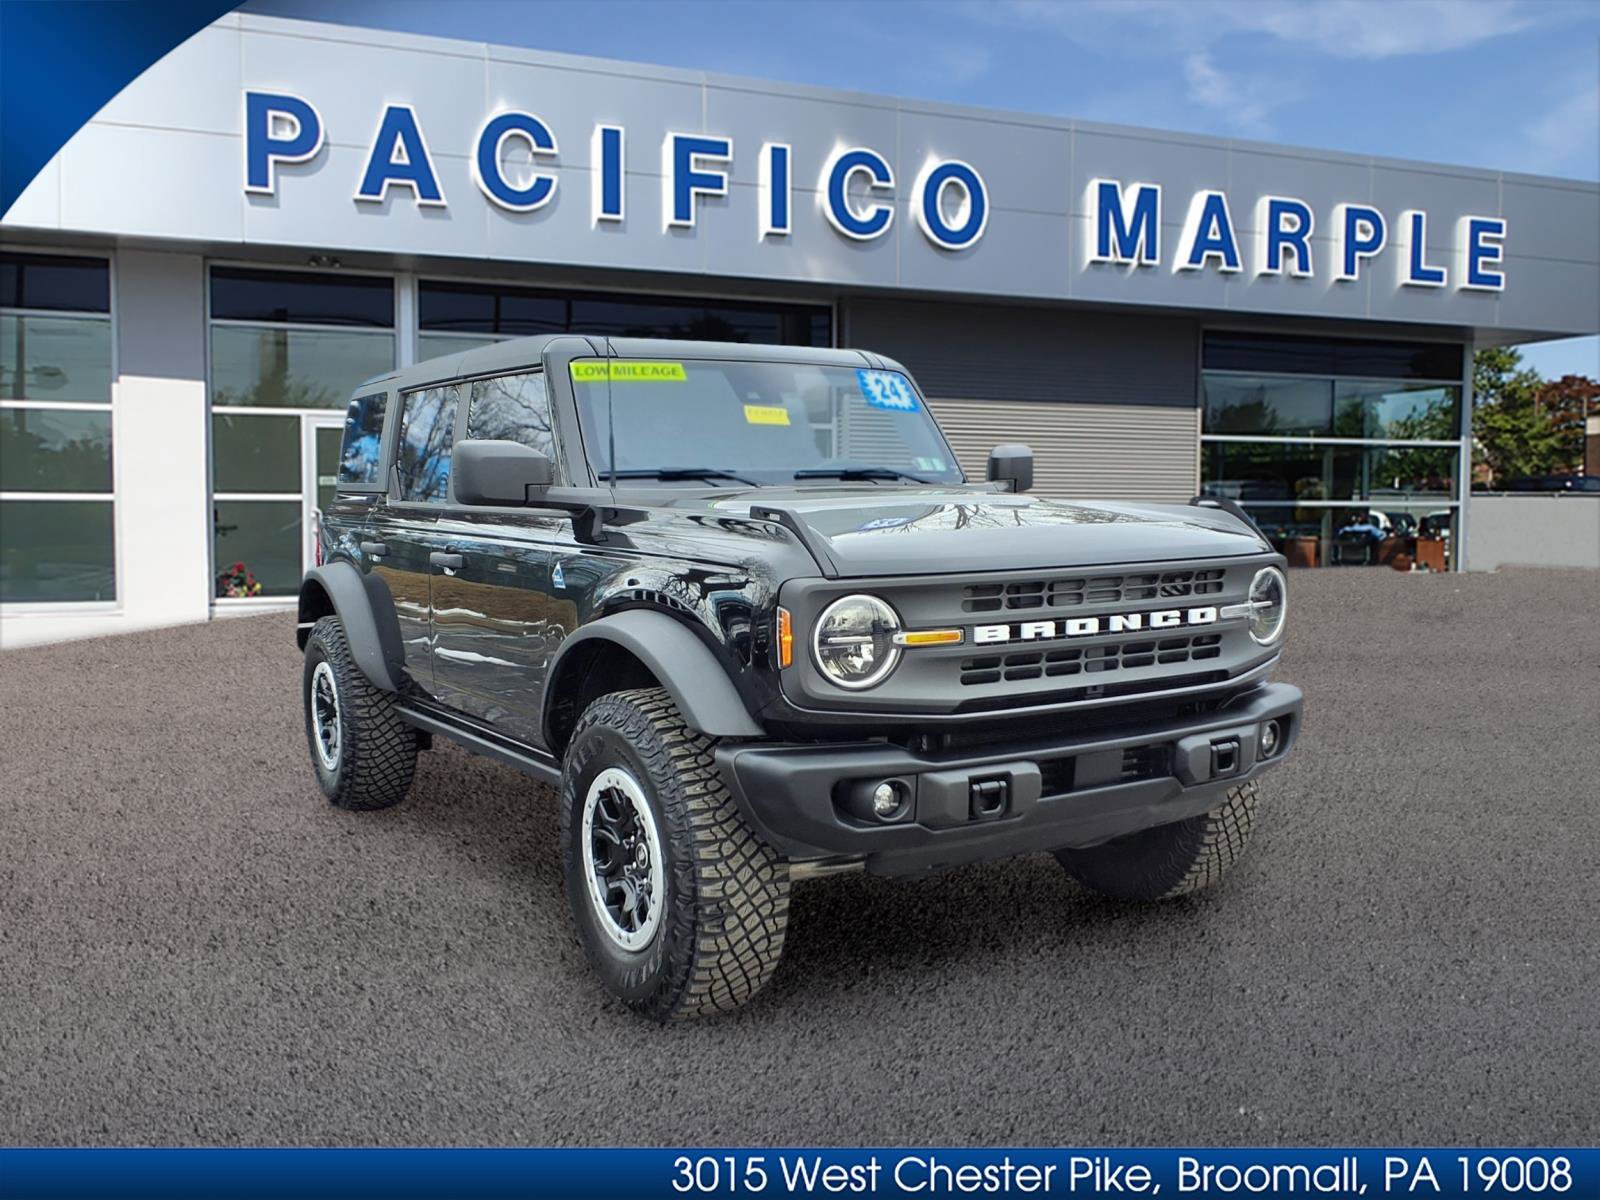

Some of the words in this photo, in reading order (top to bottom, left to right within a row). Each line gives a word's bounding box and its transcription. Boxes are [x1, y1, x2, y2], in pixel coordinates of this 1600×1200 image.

[243, 90, 989, 249] PACIFICO
[1087, 179, 1507, 290] MARPLE
[575, 365, 609, 377] LOW
[613, 365, 679, 377] MILEAGE
[974, 606, 1217, 643] BRONCO
